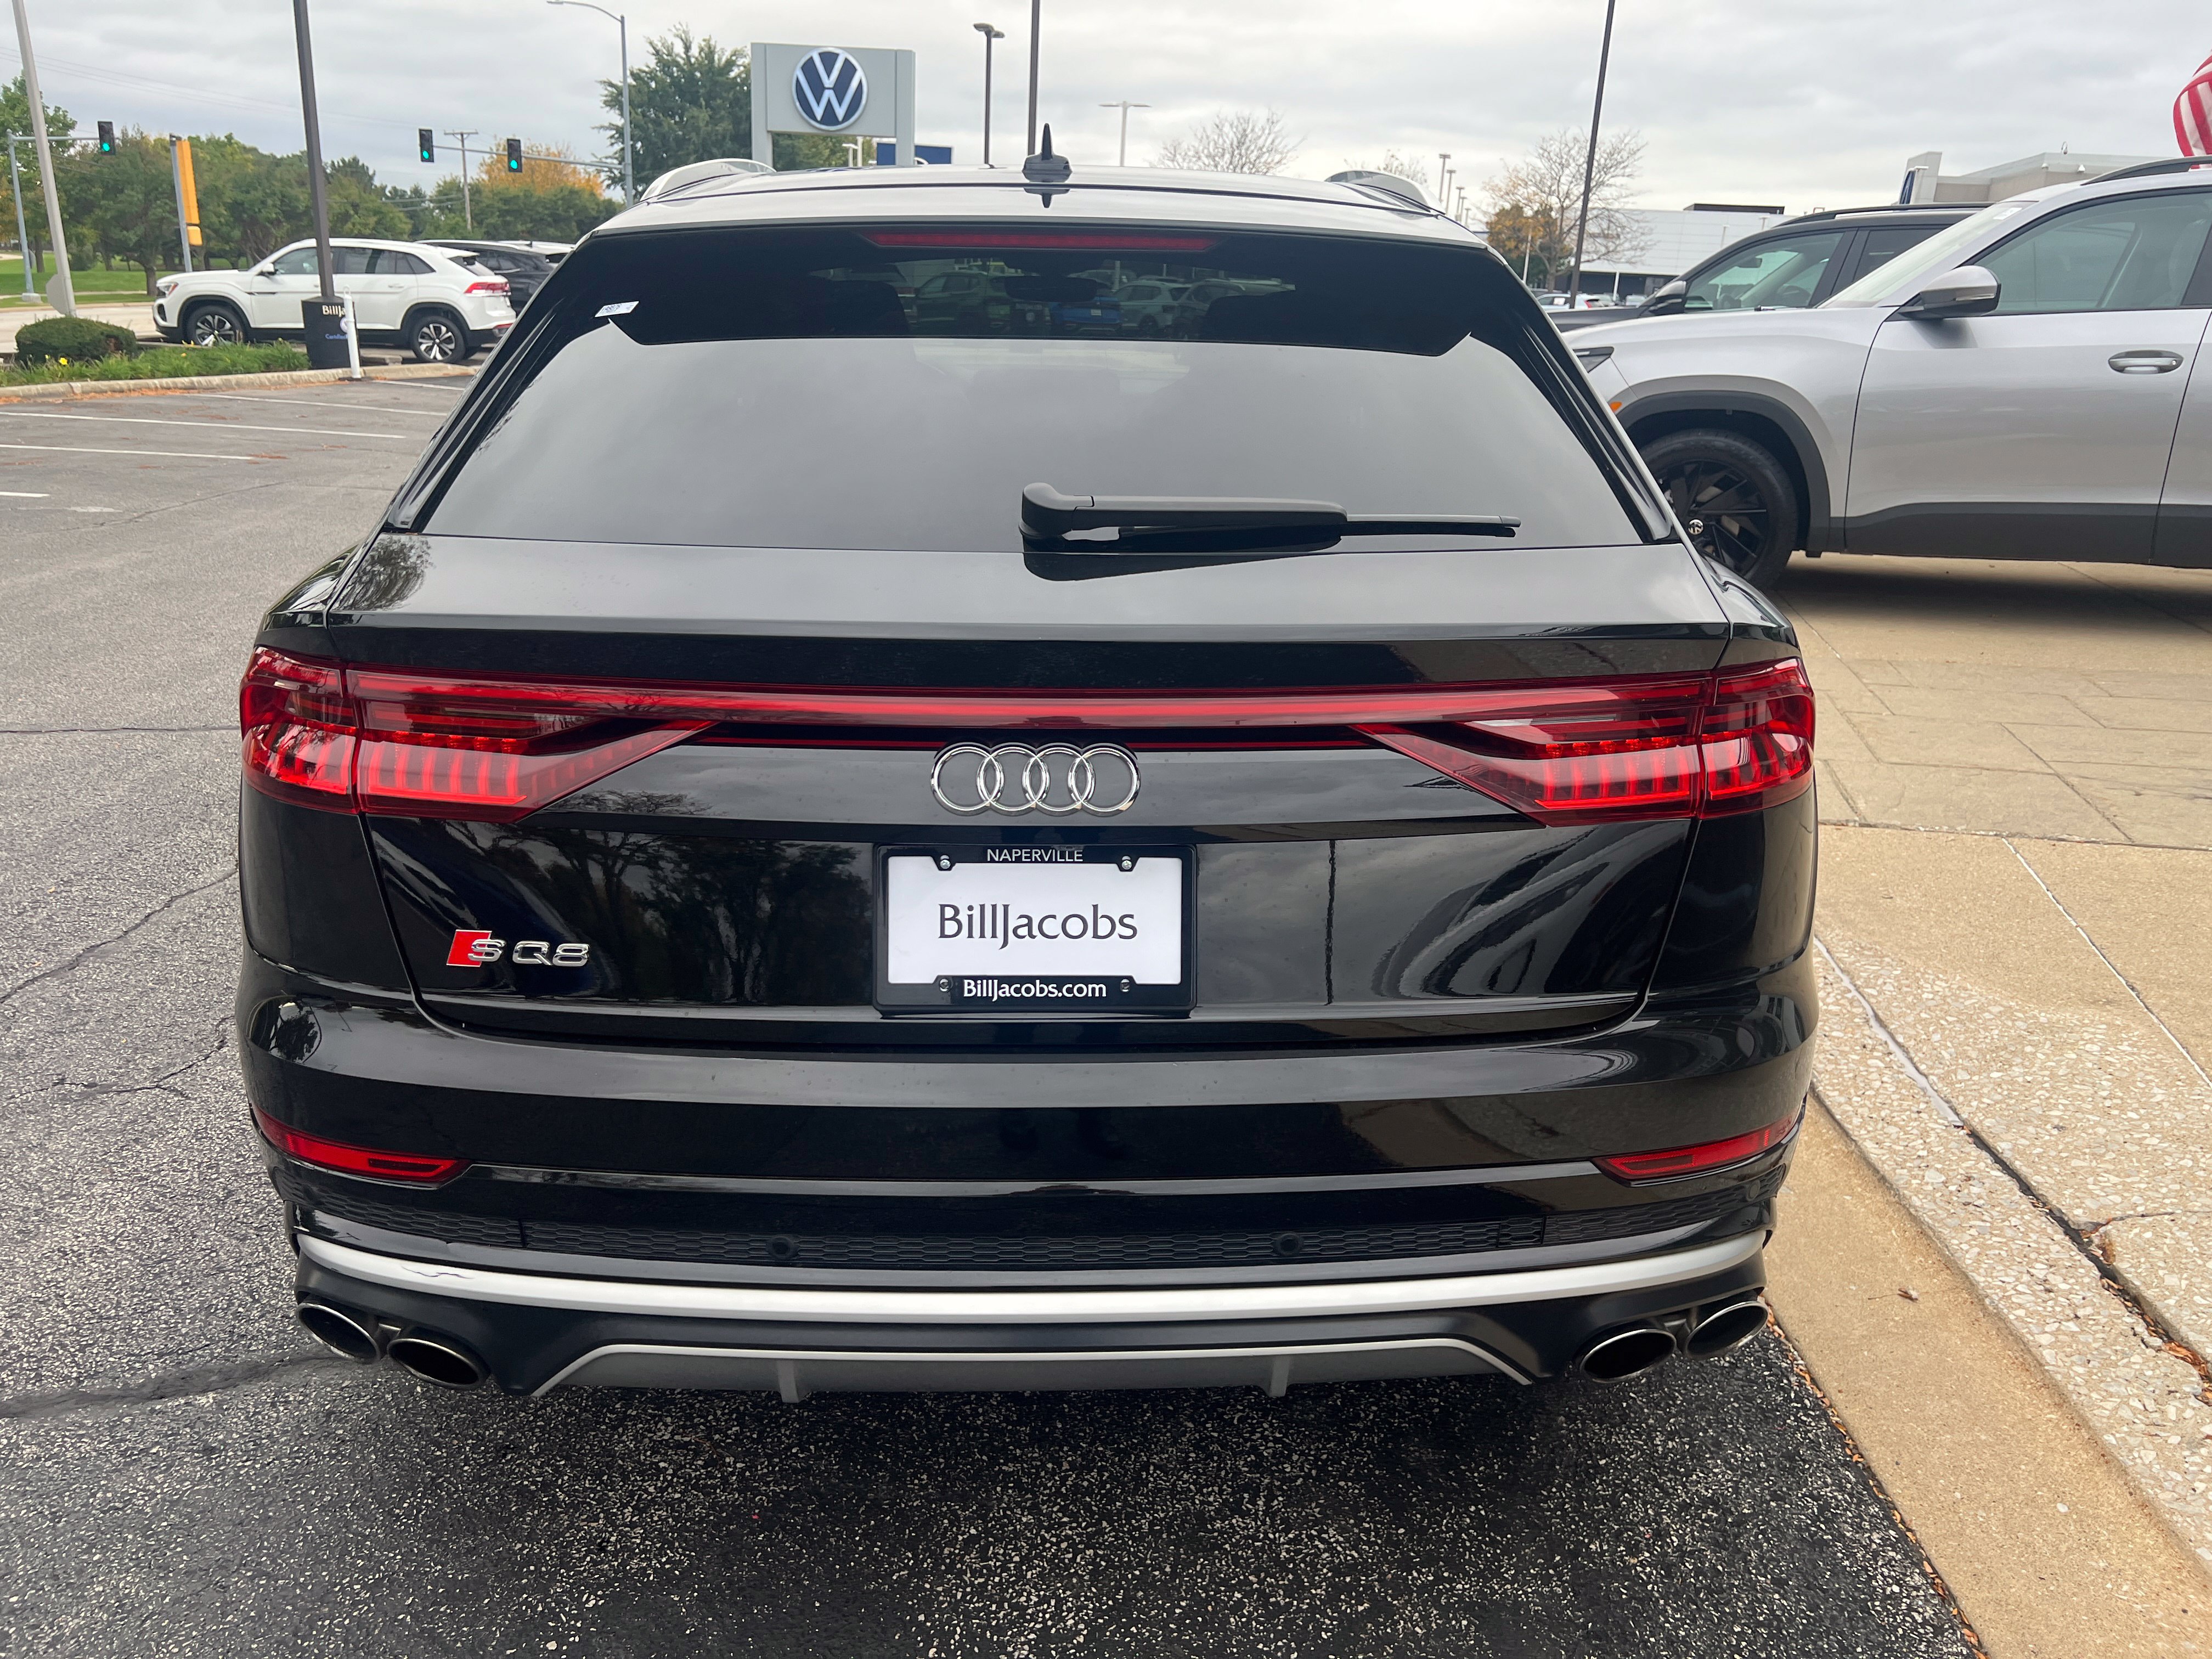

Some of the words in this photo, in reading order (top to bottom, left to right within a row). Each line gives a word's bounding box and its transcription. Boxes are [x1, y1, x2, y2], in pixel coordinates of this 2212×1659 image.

[322, 305, 346, 317] BillJa
[988, 849, 1083, 861] NAPERVILLE
[939, 904, 1137, 950] BillJacobs
[964, 980, 1106, 1001] BillJacobs.com
